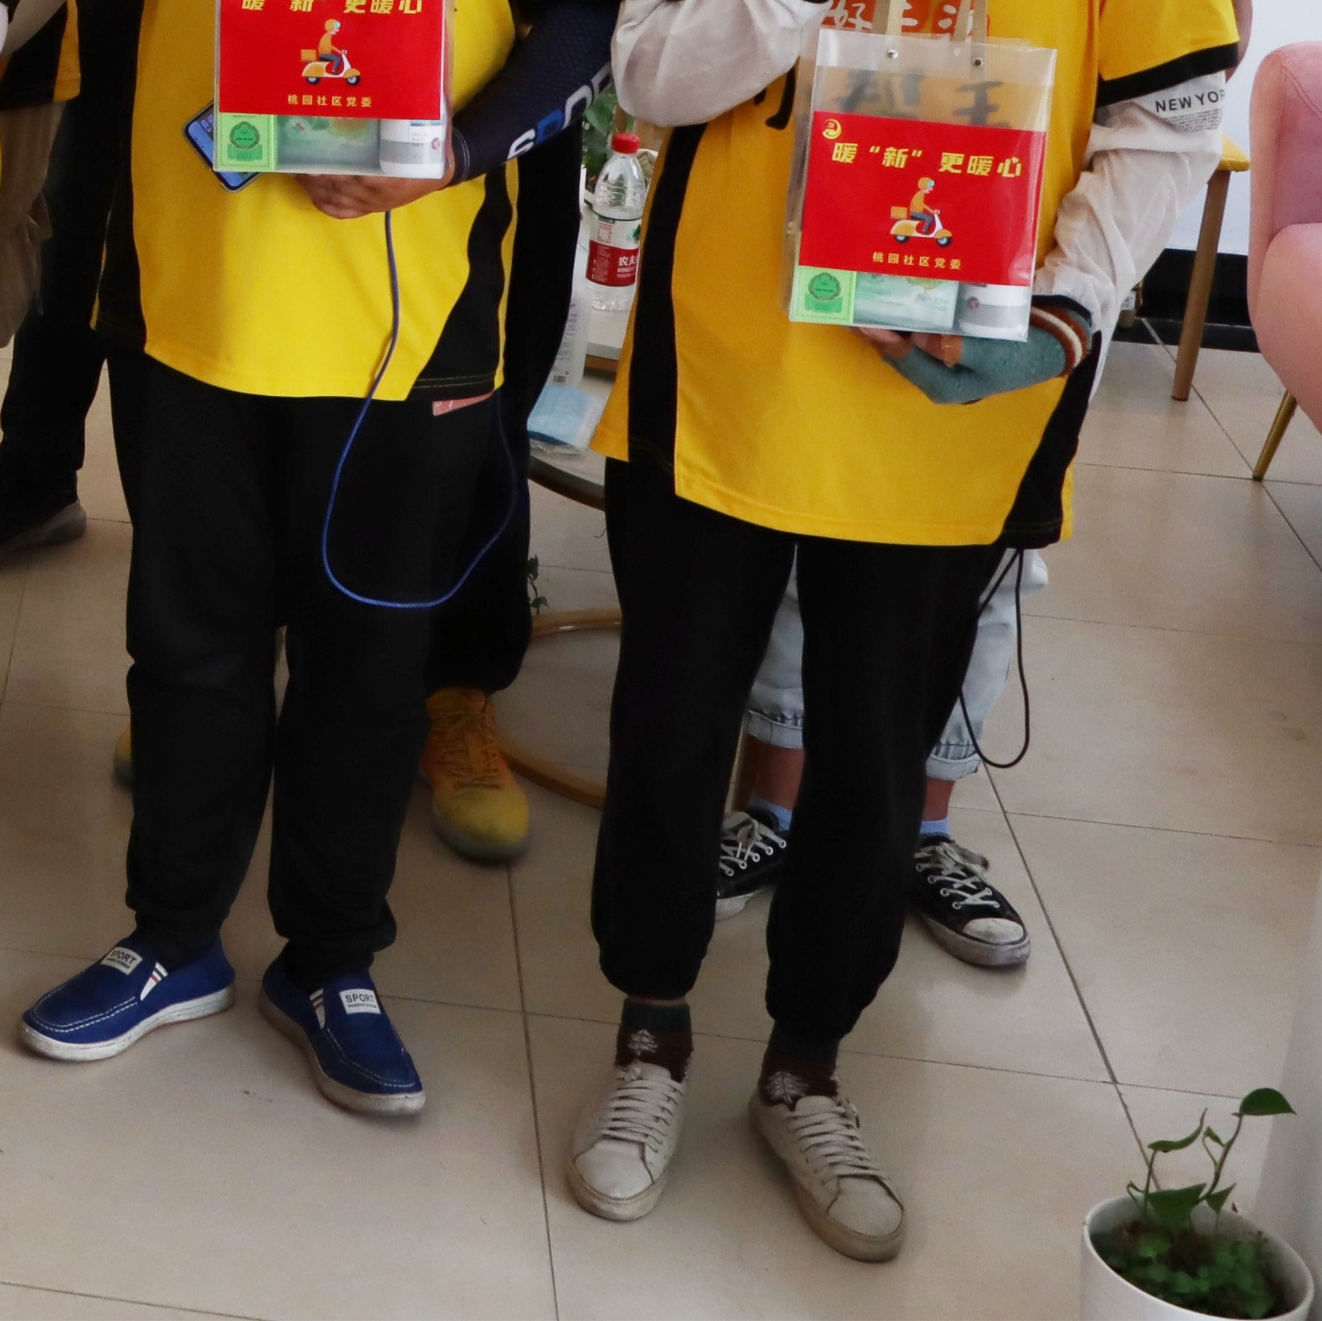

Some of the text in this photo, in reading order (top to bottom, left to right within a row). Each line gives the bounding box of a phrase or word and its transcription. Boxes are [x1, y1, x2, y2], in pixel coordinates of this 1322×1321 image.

[287, 93, 373, 109] 桃园社区党委
[1156, 95, 1192, 113] NEW
[832, 141, 1023, 178] 暖“新”更暖心
[872, 251, 961, 270] 桃园社区党委
[110, 950, 136, 965] SPORT
[346, 993, 374, 1004] SPORT
